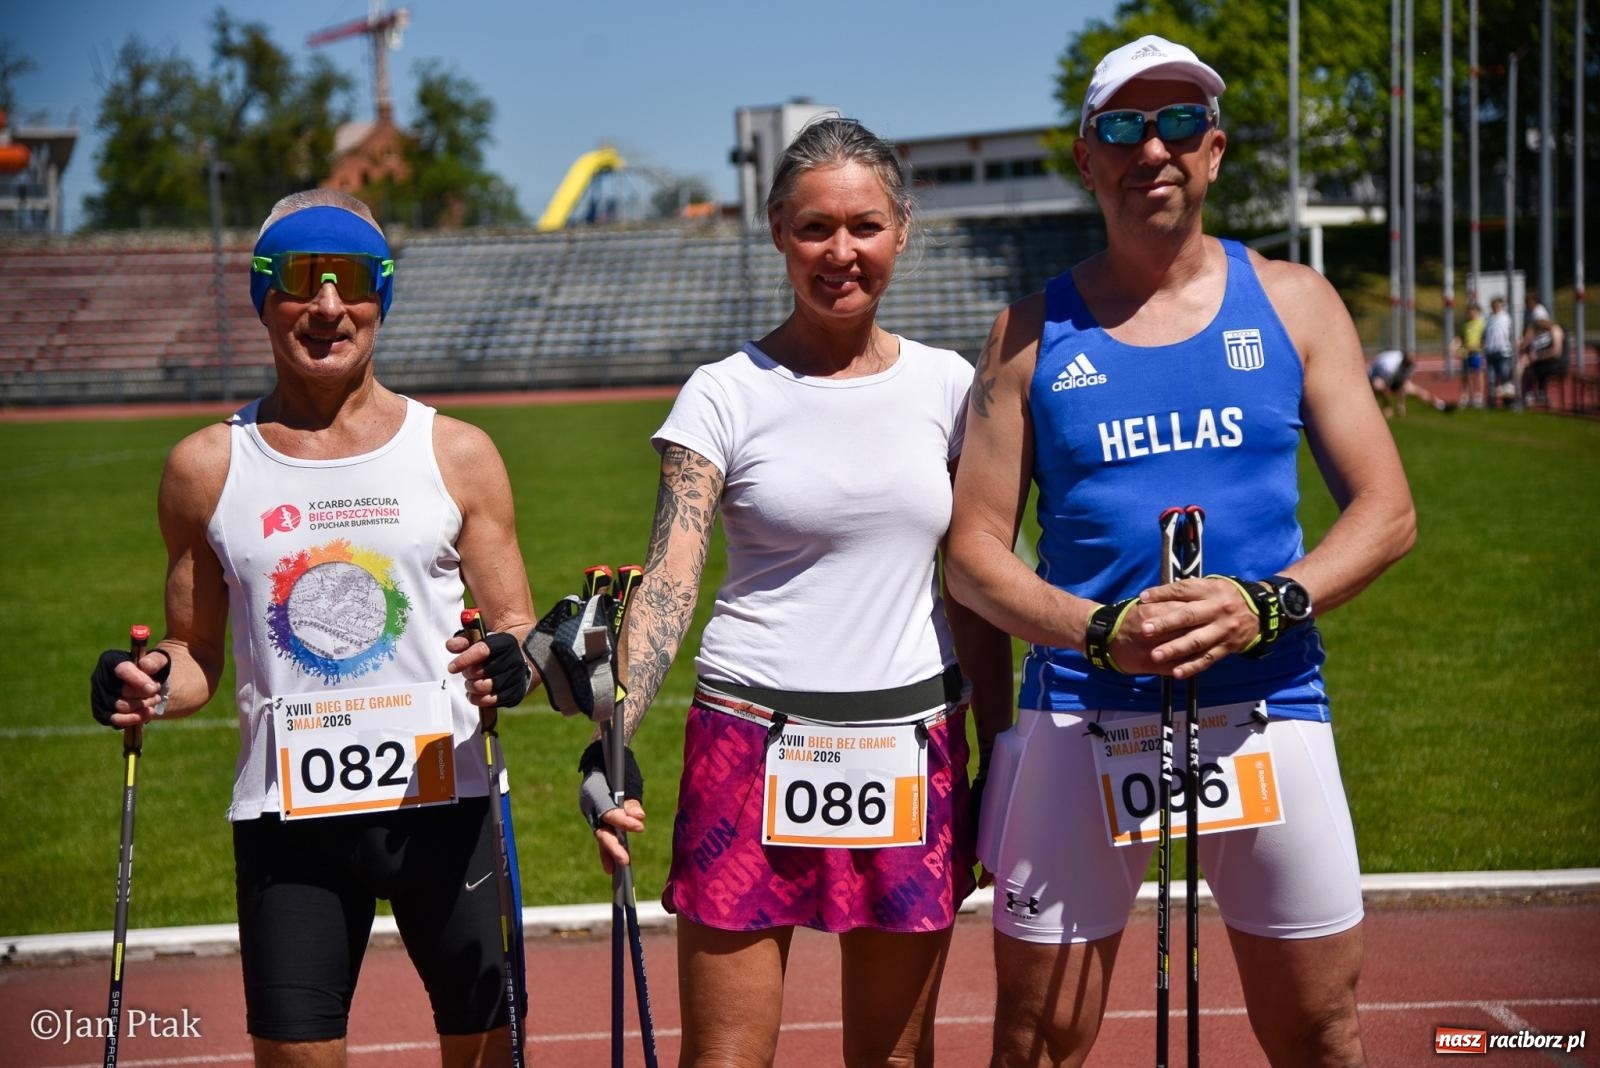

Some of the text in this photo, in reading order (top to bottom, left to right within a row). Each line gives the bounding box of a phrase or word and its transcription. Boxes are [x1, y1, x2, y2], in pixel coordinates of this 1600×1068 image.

[1052, 372, 1108, 392] adidas
[1098, 406, 1244, 462] HELLAS
[308, 498, 399, 511] X CARBO ASECURA
[309, 506, 400, 522] BIEG PSZCZYŃSKI
[309, 517, 400, 531] O PUCHAR BURMISTRZA
[1266, 596, 1281, 643] LEKI
[285, 693, 412, 717] XVIII BIEG BEZ GRANIC
[286, 713, 352, 732] 3MAJA2026
[779, 733, 897, 750] XVIII BIEG BEZ GRANIC
[1104, 727, 1130, 744] XVIII
[1132, 724, 1158, 740] BIEG
[778, 747, 841, 763] 3MAJA2026
[1105, 738, 1163, 758] 3MAJA202
[1162, 725, 1173, 782] LEKI
[301, 740, 408, 793] 082
[784, 779, 887, 827] 086
[692, 817, 738, 874] RUN
